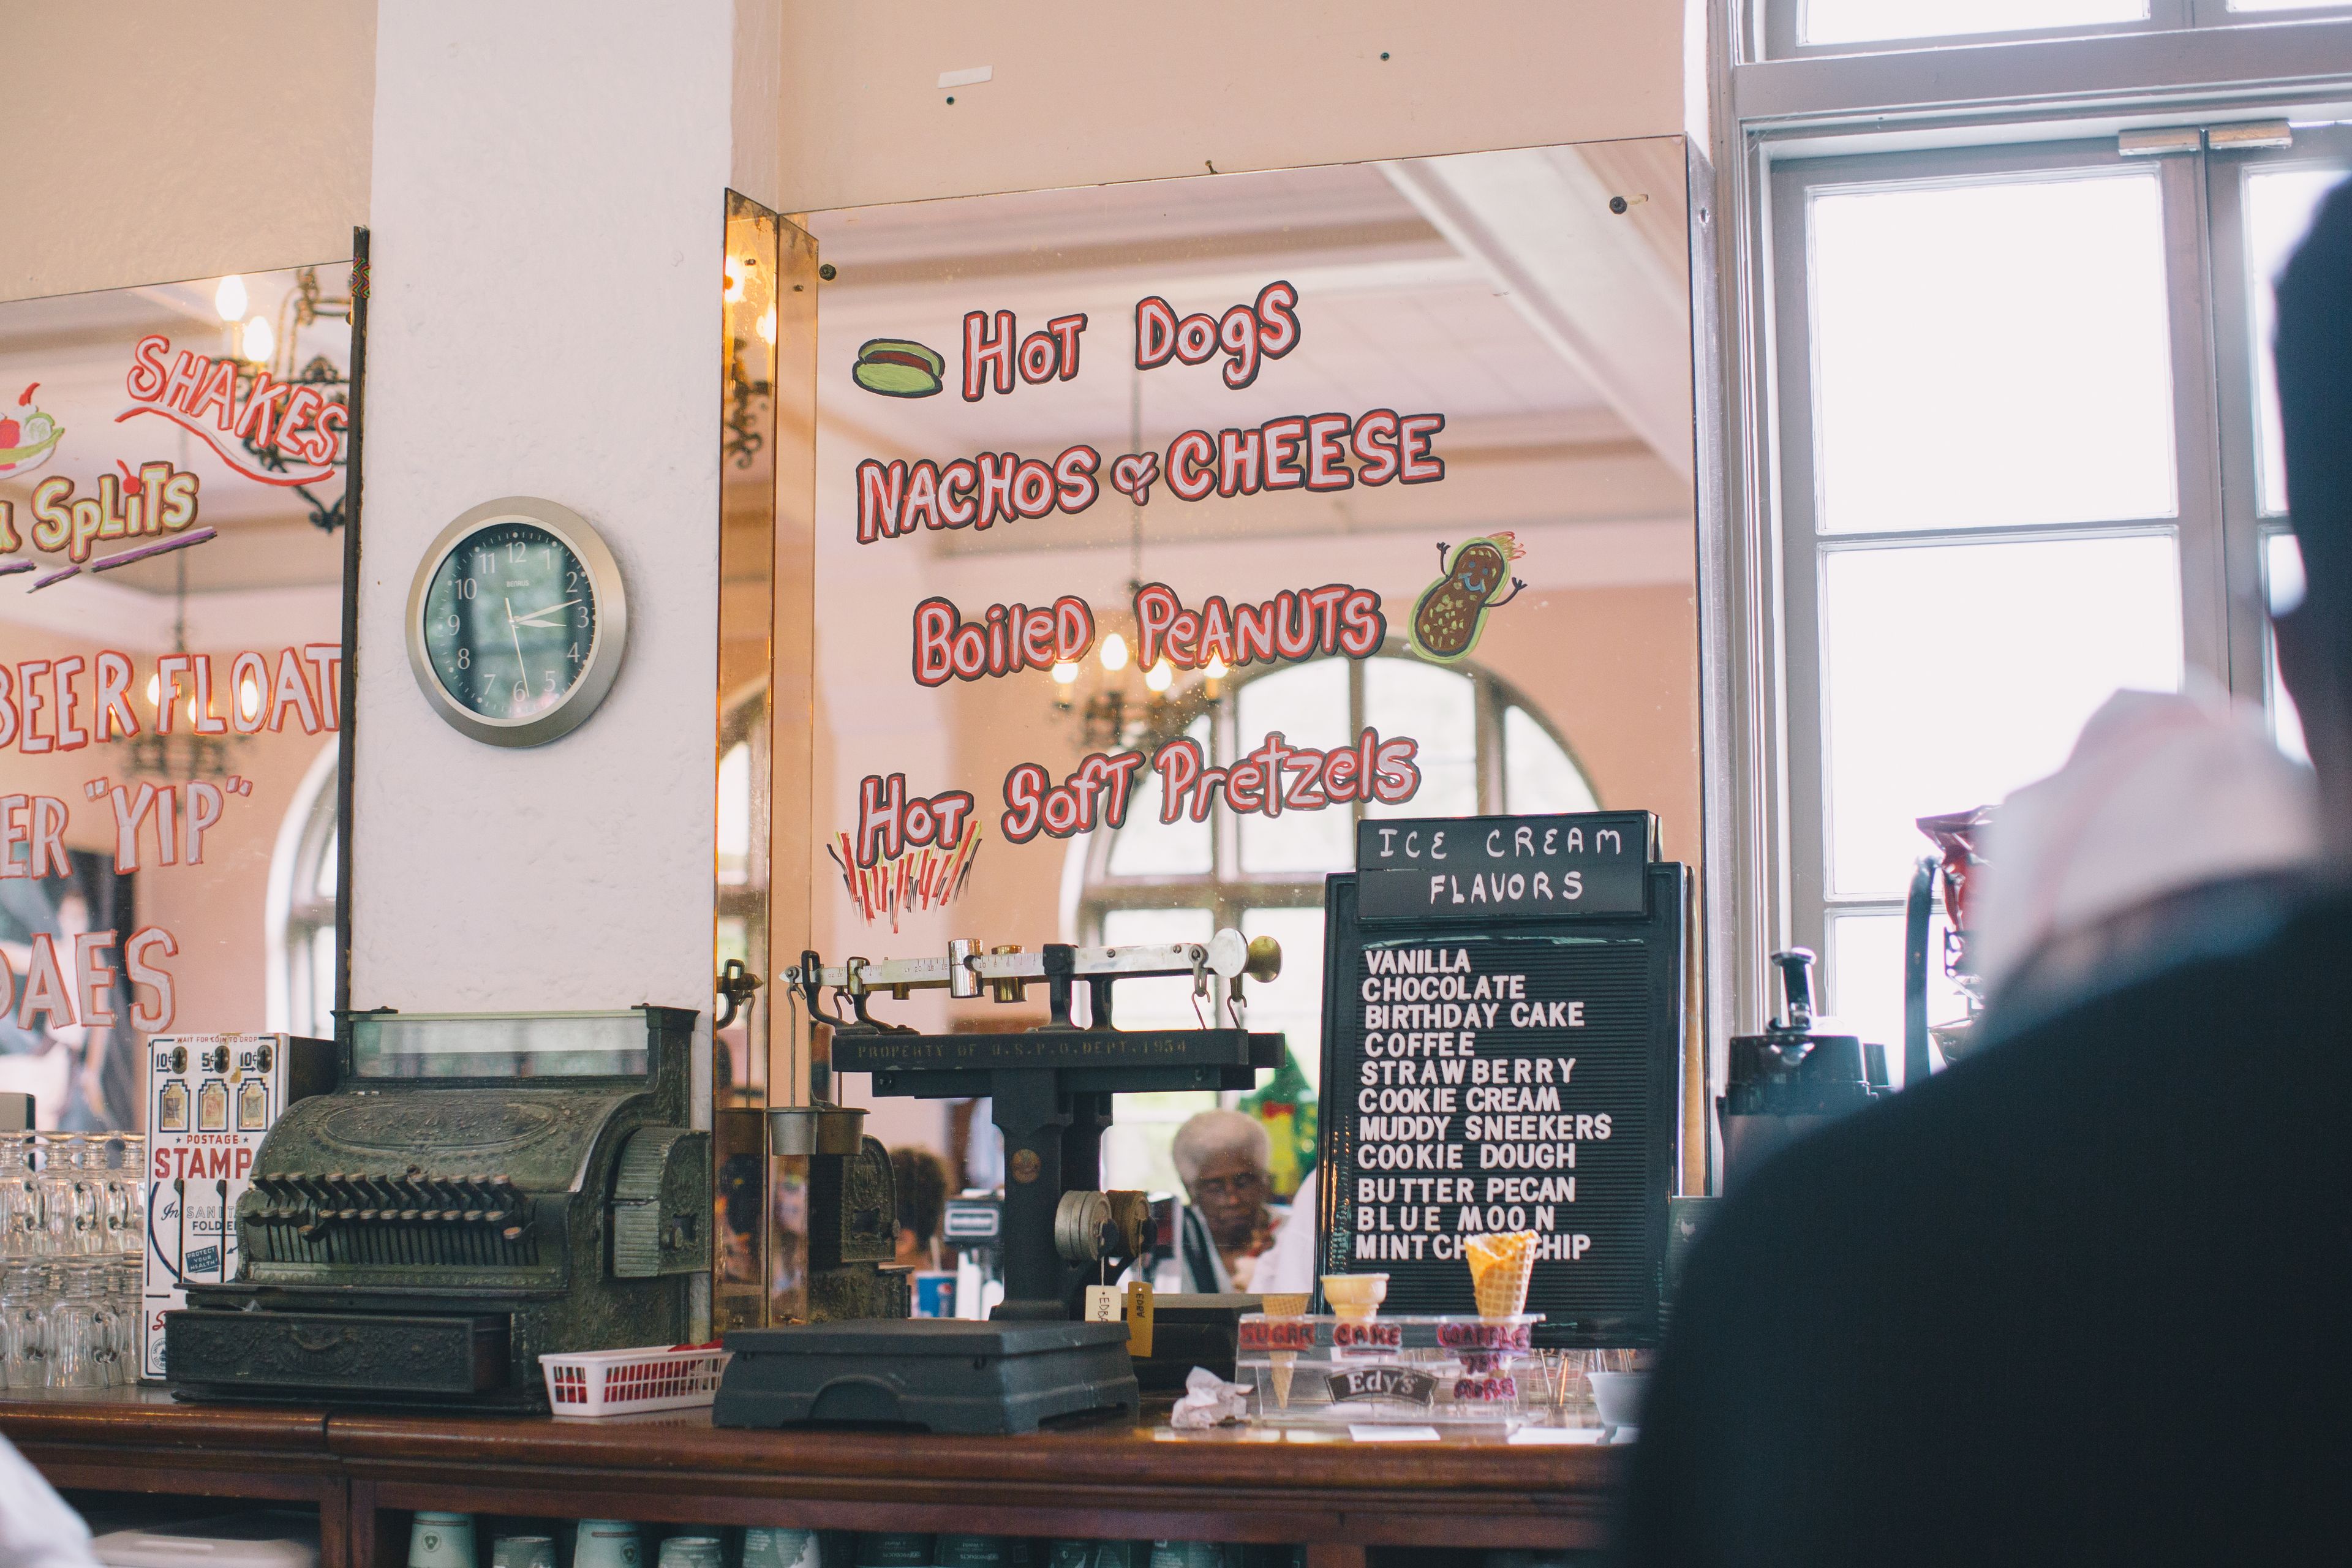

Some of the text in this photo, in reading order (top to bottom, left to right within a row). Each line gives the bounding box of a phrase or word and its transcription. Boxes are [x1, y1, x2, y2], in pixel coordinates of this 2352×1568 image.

[127, 334, 348, 466] SHAKES
[856, 409, 1444, 545] NACHOS & CHEESE
[480, 552, 495, 574] 11
[505, 542, 526, 563] 12
[543, 549, 551, 570] 1
[455, 578, 477, 600] 10
[566, 571, 578, 592] 2
[448, 615, 460, 636] 9
[578, 606, 589, 628] 3
[458, 648, 470, 669] 8
[567, 642, 580, 662] 4
[156, 643, 342, 735] FLOAT
[484, 674, 496, 695] 7
[513, 681, 526, 701] 6
[545, 671, 556, 692] 5
[1153, 726, 1421, 825] Pretzels
[1378, 826, 1621, 859] ICE CREAM
[1431, 871, 1583, 905] FLAVORS
[1365, 949, 1471, 975] VANILLA
[1362, 974, 1526, 1003] CHOCOLATE
[1365, 1001, 1585, 1029] BIRTHDAY CAKE
[858, 1044, 943, 1059] PROPERTY
[957, 1043, 976, 1057] OF
[1365, 1031, 1476, 1058] COFFEE
[1361, 1058, 1577, 1085] STRAWBERRY
[1358, 1086, 1561, 1113] COOKIE CREAM
[187, 1135, 238, 1144] POSTAGE
[1359, 1114, 1612, 1142] MUDDY SNEEKERS
[155, 1148, 252, 1179] STAMP
[1357, 1144, 1576, 1170] COOKIE DOUGH
[1358, 1177, 1576, 1204] BUTTER PECAN
[161, 1200, 235, 1221] In SANIT
[1358, 1205, 1555, 1232] BLUE MOON
[187, 1247, 215, 1258] PROTECT
[1355, 1234, 1428, 1260] MINT
[1240, 1322, 1314, 1344] SUGAR
[1334, 1323, 1401, 1346] CAKE
[1437, 1324, 1529, 1350] WAFFLE
[1349, 1370, 1419, 1395] Edy's
